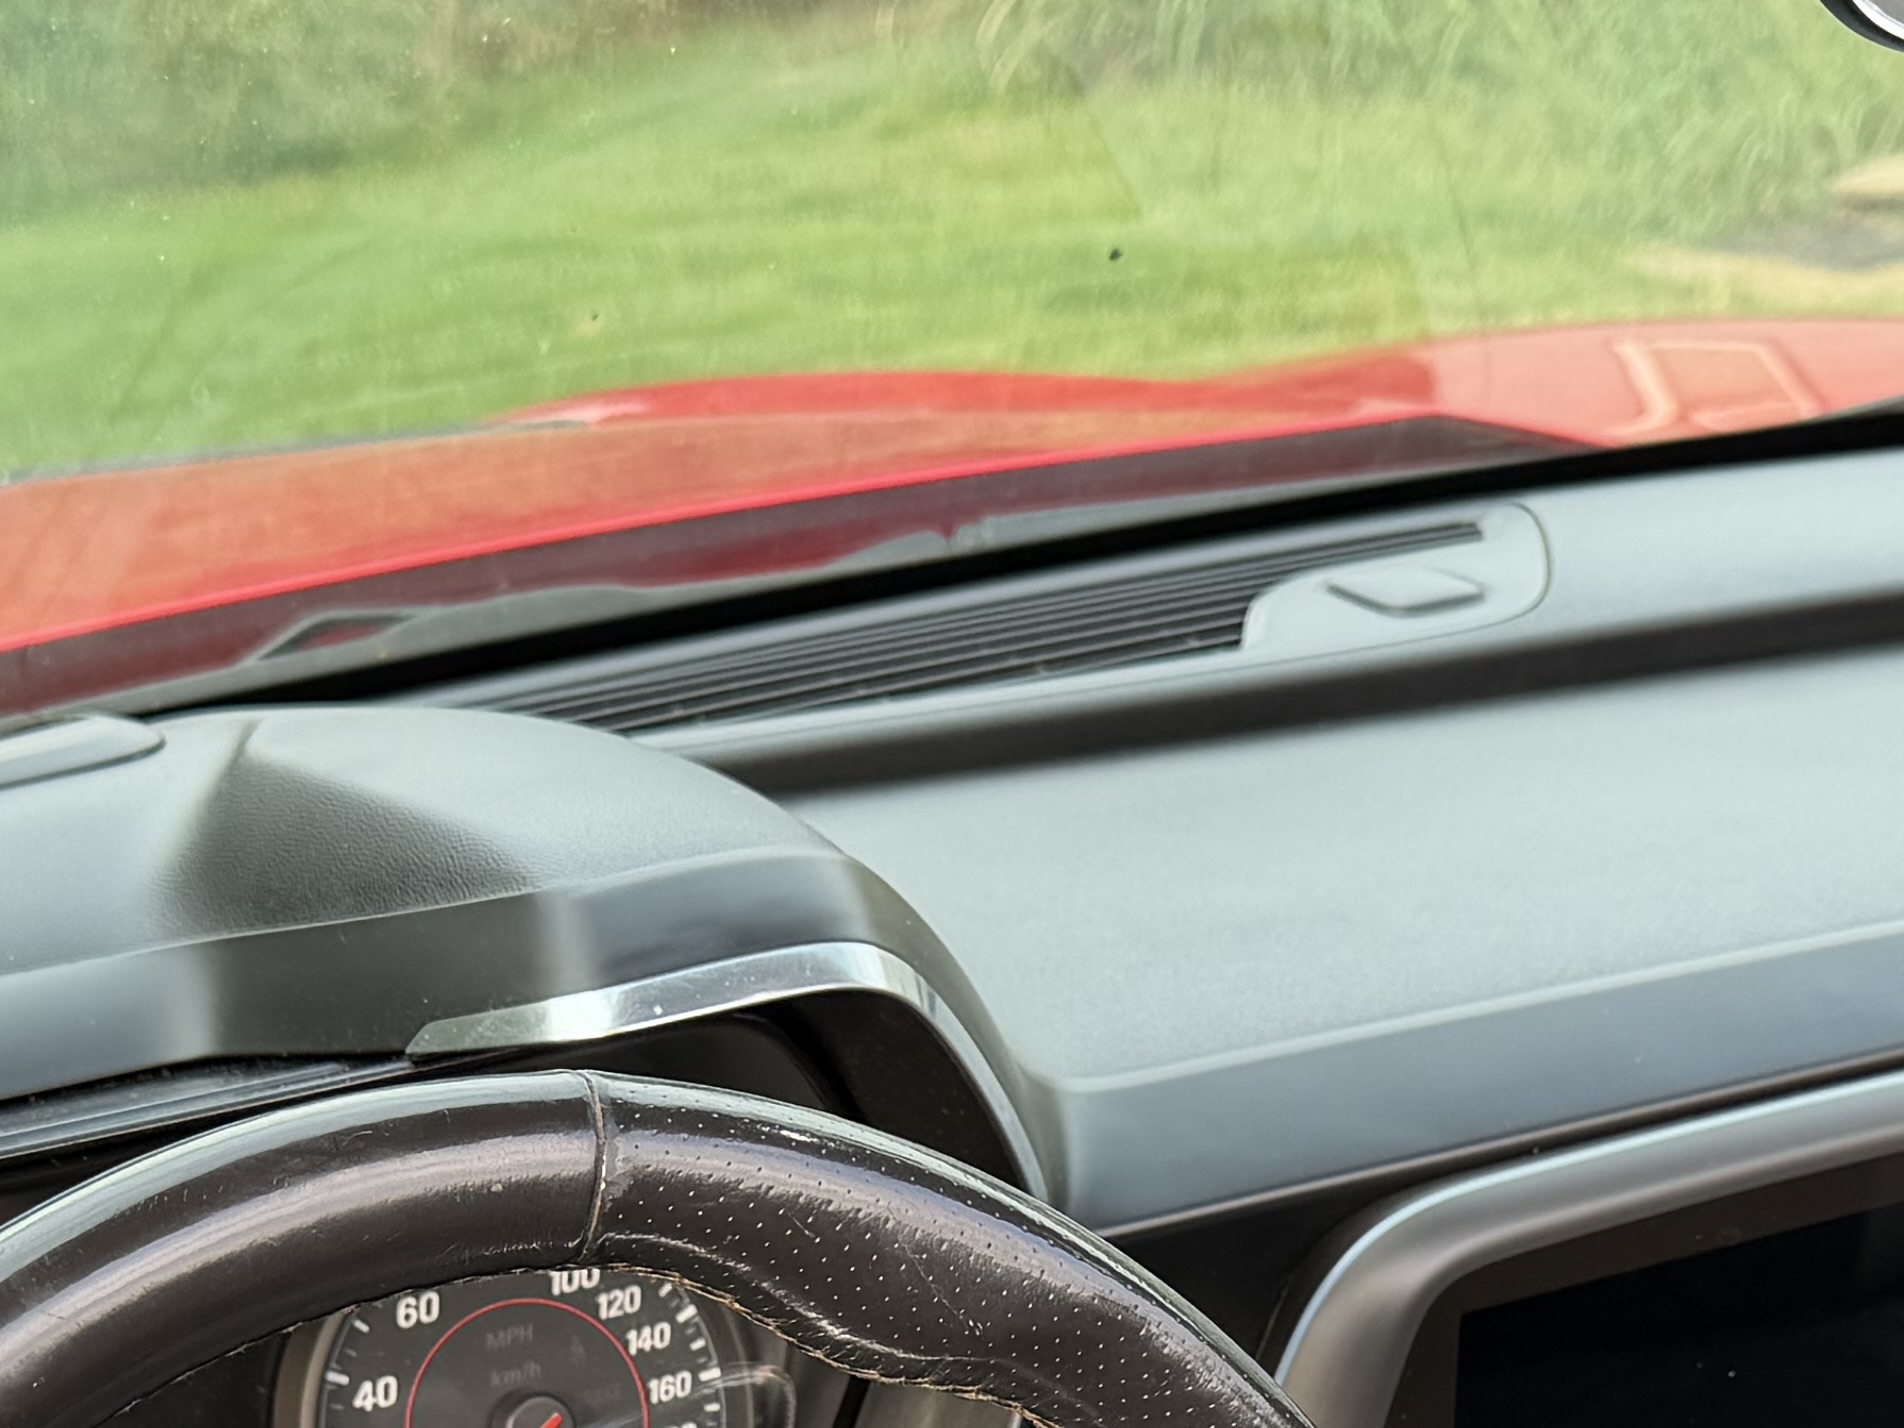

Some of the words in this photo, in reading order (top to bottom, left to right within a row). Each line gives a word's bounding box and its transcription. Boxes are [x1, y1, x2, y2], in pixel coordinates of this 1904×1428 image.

[549, 1268, 601, 1296] 100
[396, 1292, 440, 1329] 60
[597, 1285, 641, 1320] 120
[625, 1322, 671, 1356] 140
[353, 1374, 398, 1413] 40
[649, 1370, 691, 1404] 160
